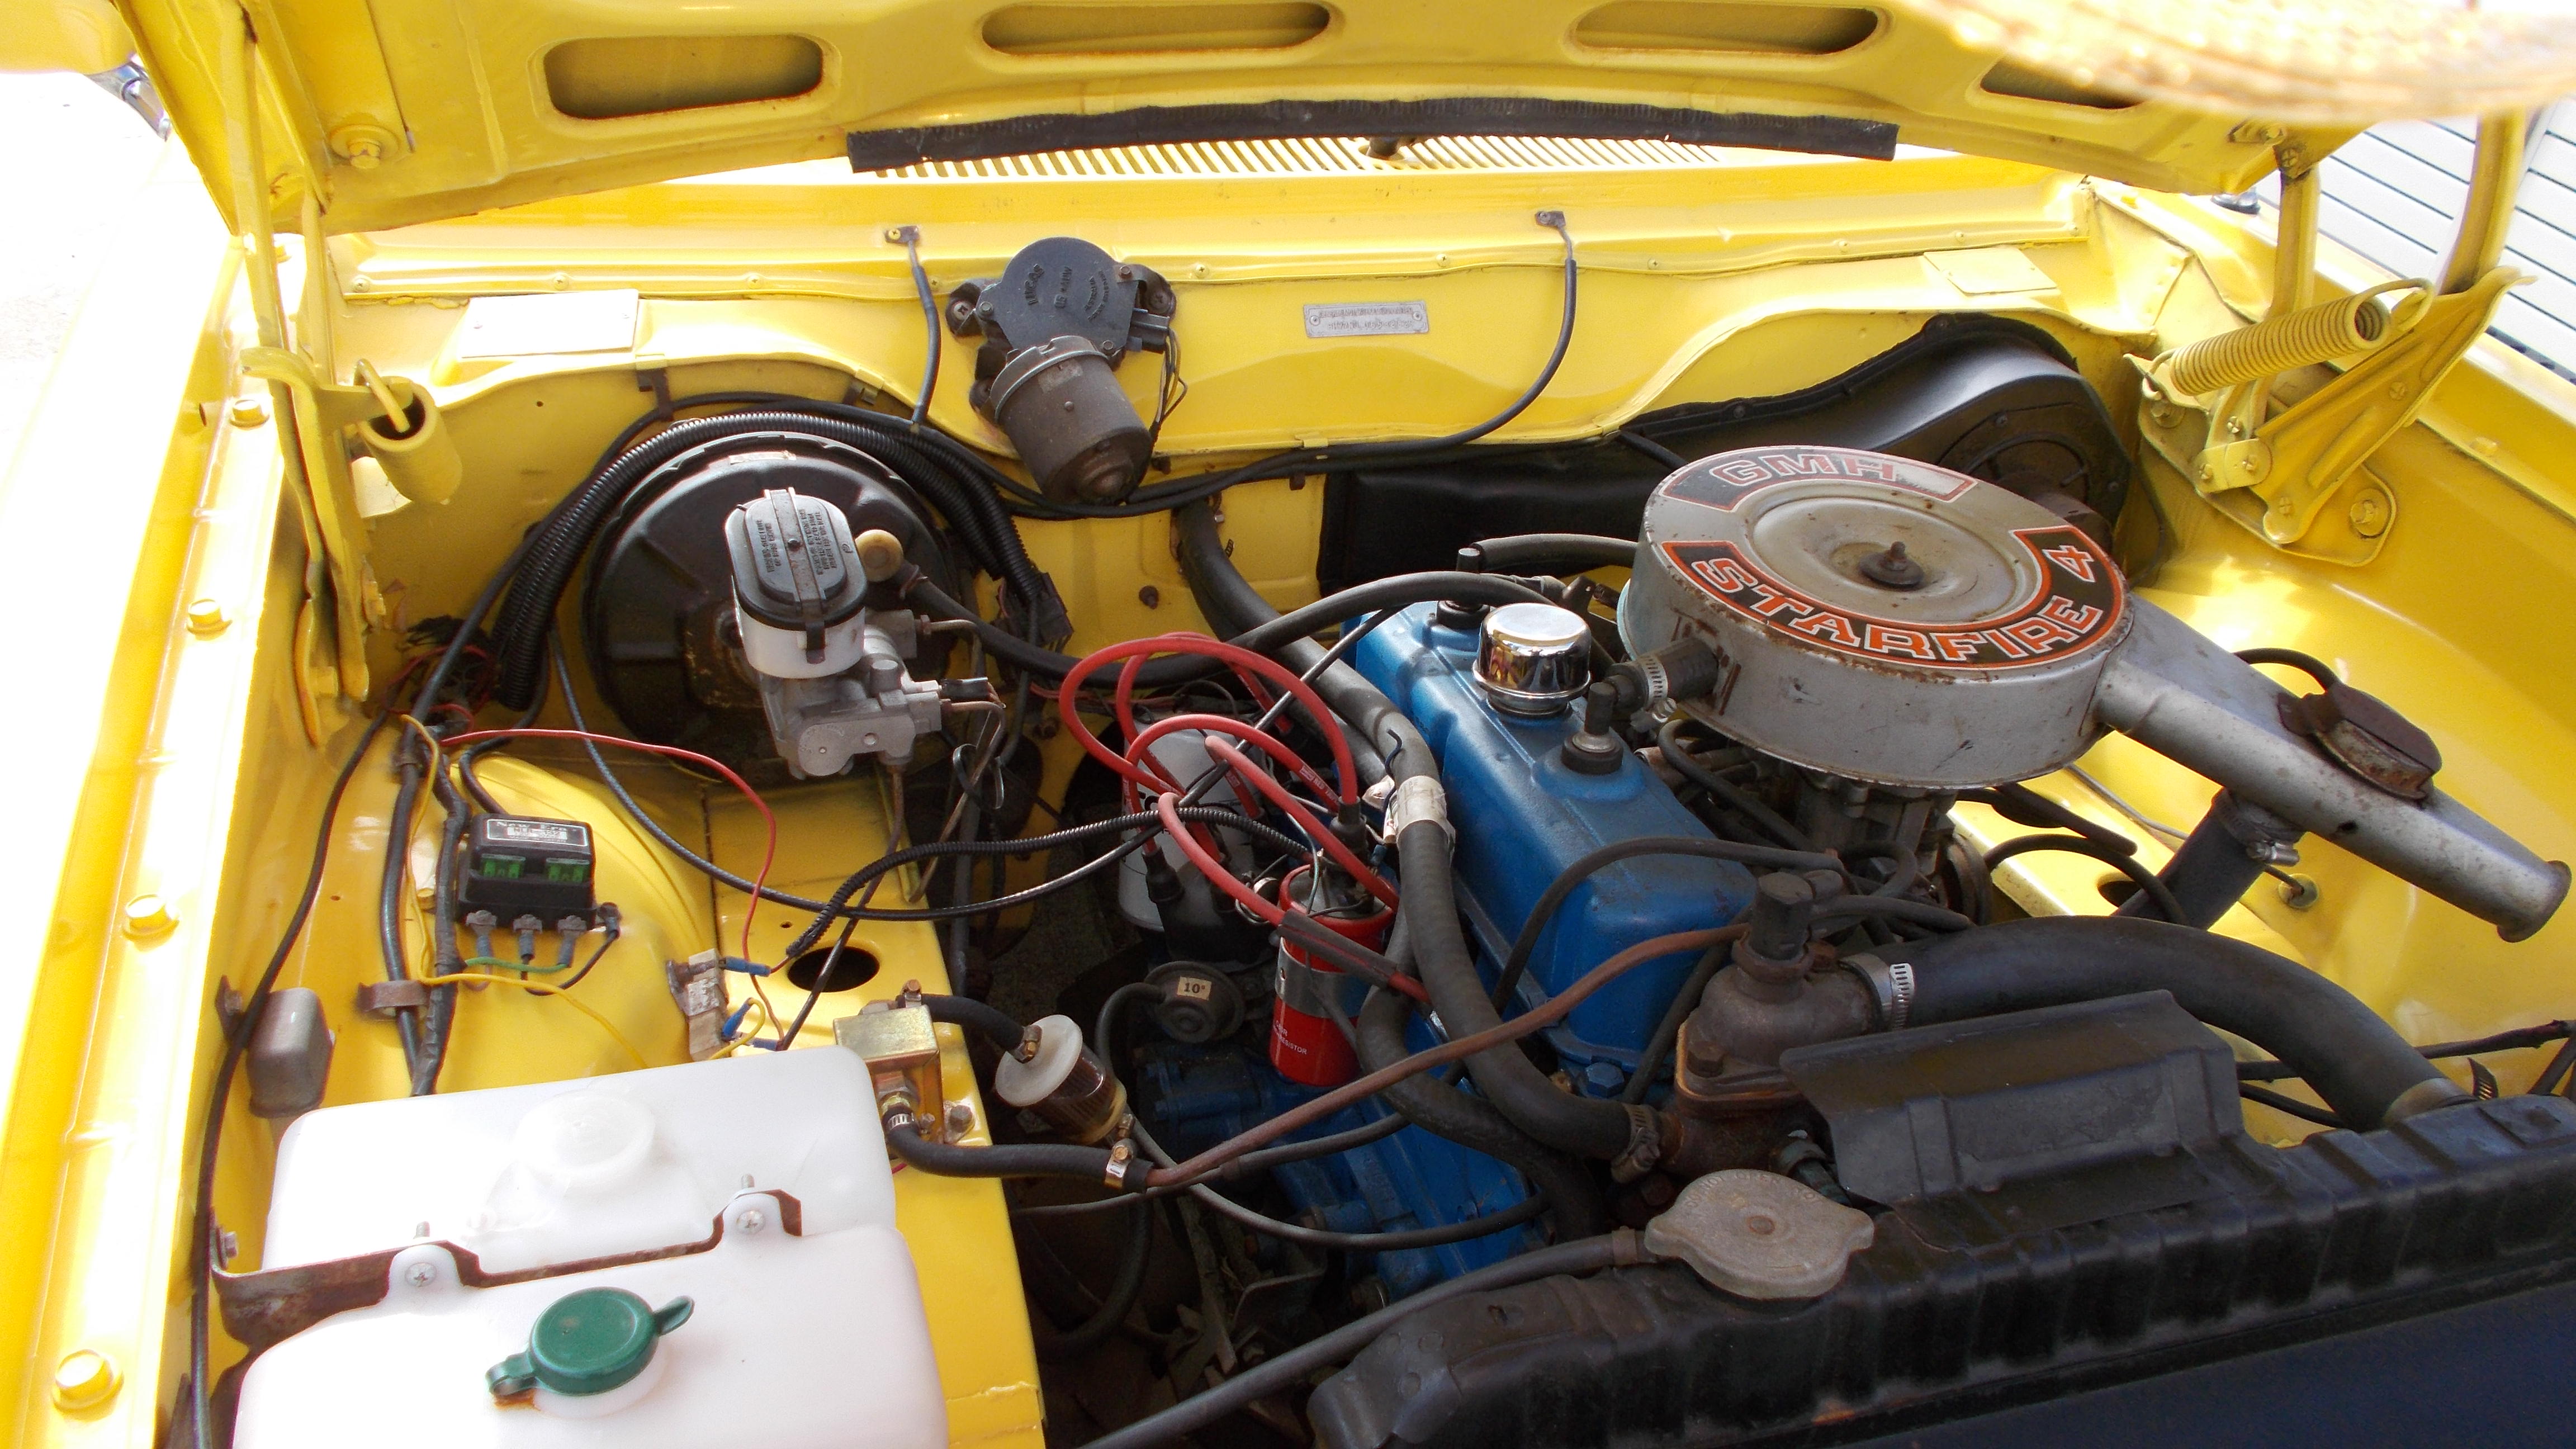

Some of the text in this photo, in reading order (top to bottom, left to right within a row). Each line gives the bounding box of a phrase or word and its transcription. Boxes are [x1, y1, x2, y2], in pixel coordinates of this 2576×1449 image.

[1709, 454, 1897, 487] GMH
[1692, 544, 2105, 664] STARFIRE 4
